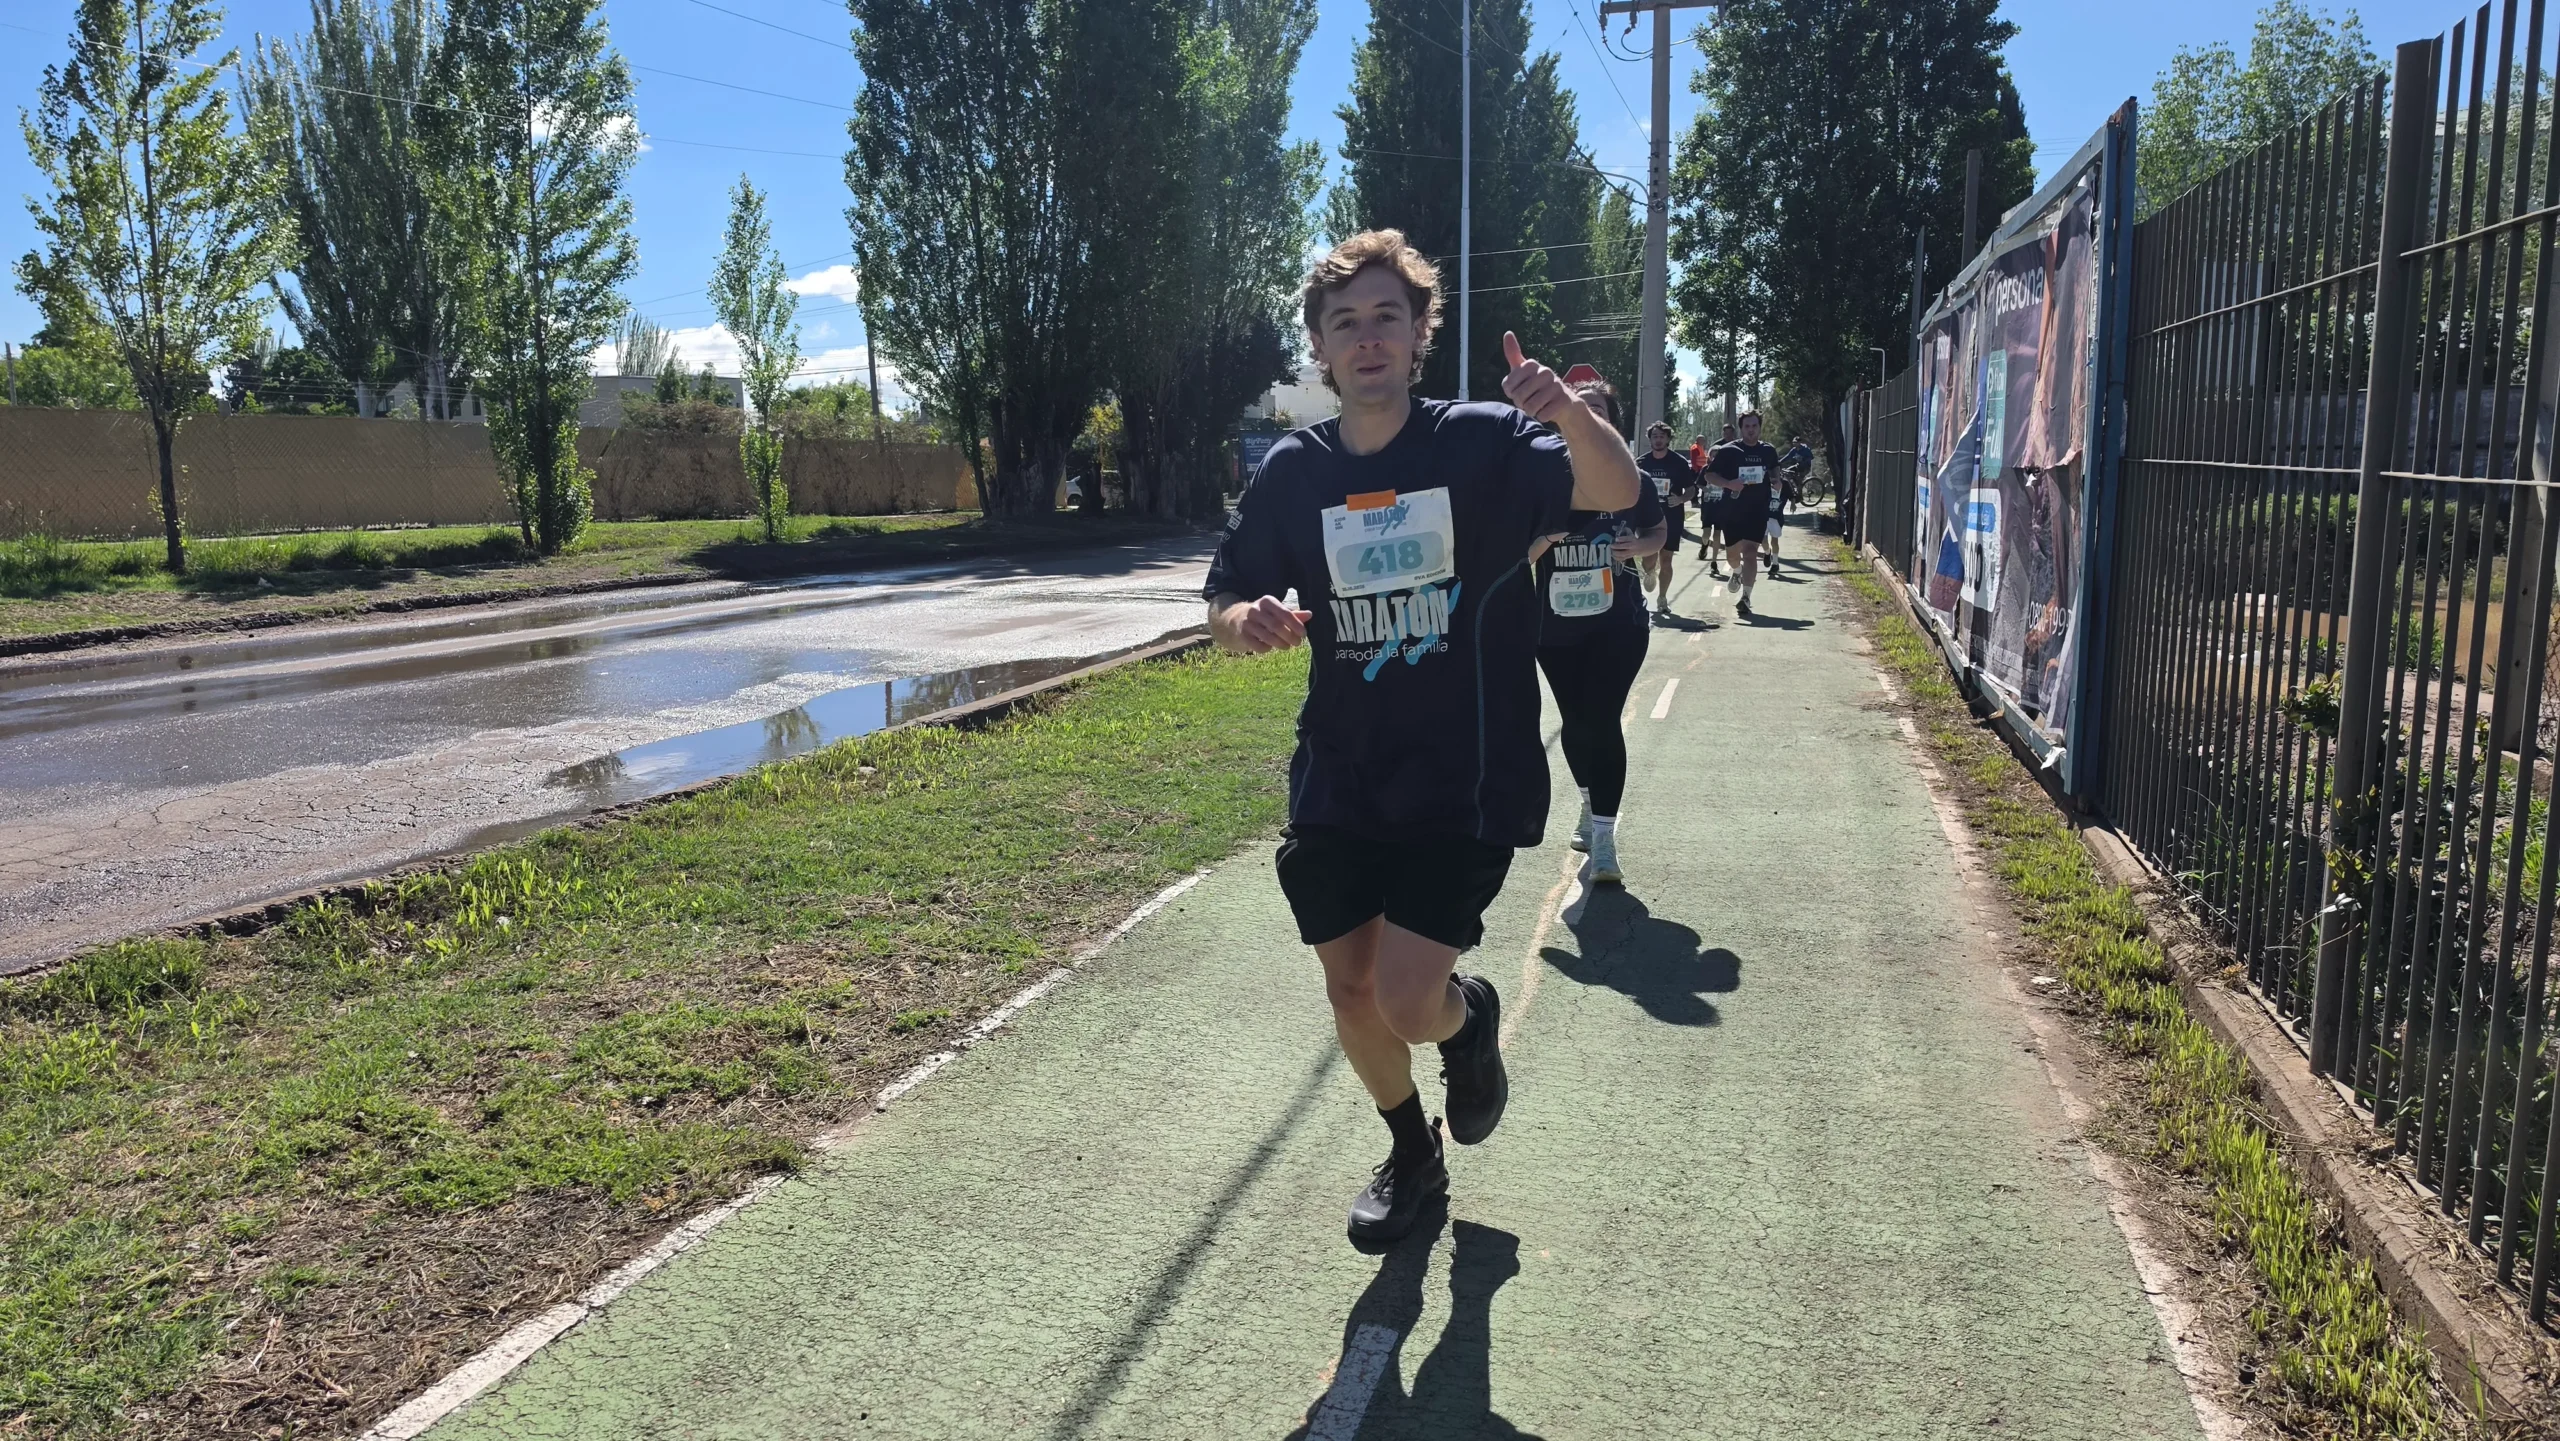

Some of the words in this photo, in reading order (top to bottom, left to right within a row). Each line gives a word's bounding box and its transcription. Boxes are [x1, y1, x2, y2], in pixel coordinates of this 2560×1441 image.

[1995, 265, 2044, 327] persona
[1358, 540, 1424, 575] 418
[1563, 592, 1600, 608] 278
[1355, 647, 1382, 661] oda
[1387, 645, 1398, 658] la
[1402, 640, 1449, 657] familia
